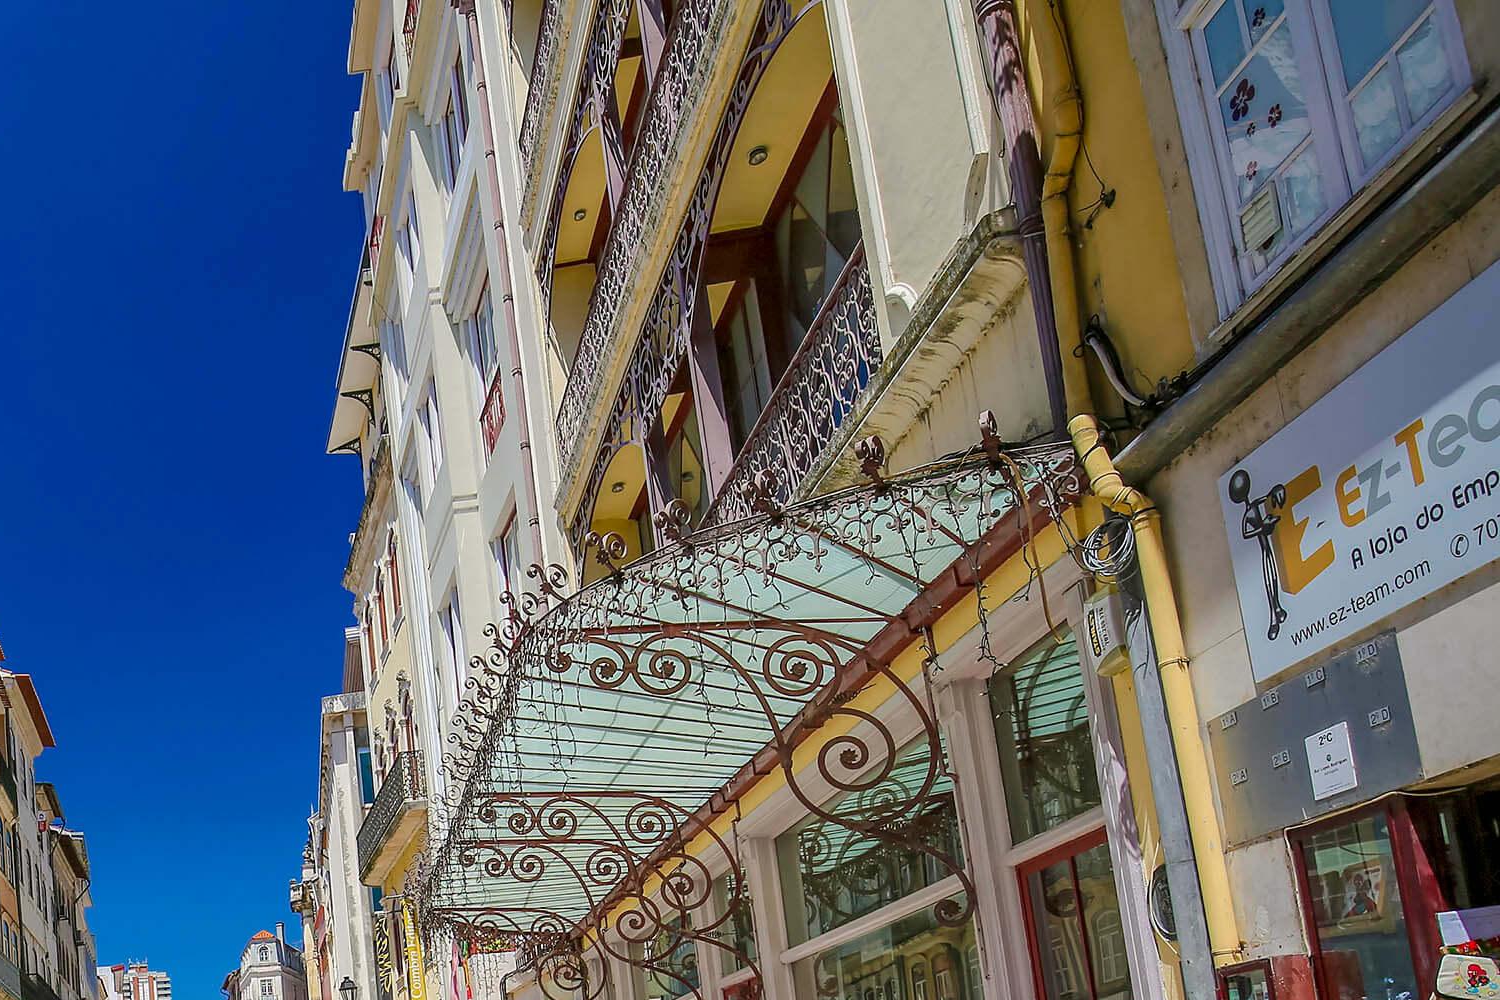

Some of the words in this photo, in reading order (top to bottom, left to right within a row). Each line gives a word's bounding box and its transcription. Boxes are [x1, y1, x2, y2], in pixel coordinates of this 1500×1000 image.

[1351, 548, 1364, 570] A
[1369, 526, 1408, 560] loja
[1416, 502, 1444, 530] do
[1290, 559, 1431, 647] www.ez-team.com
